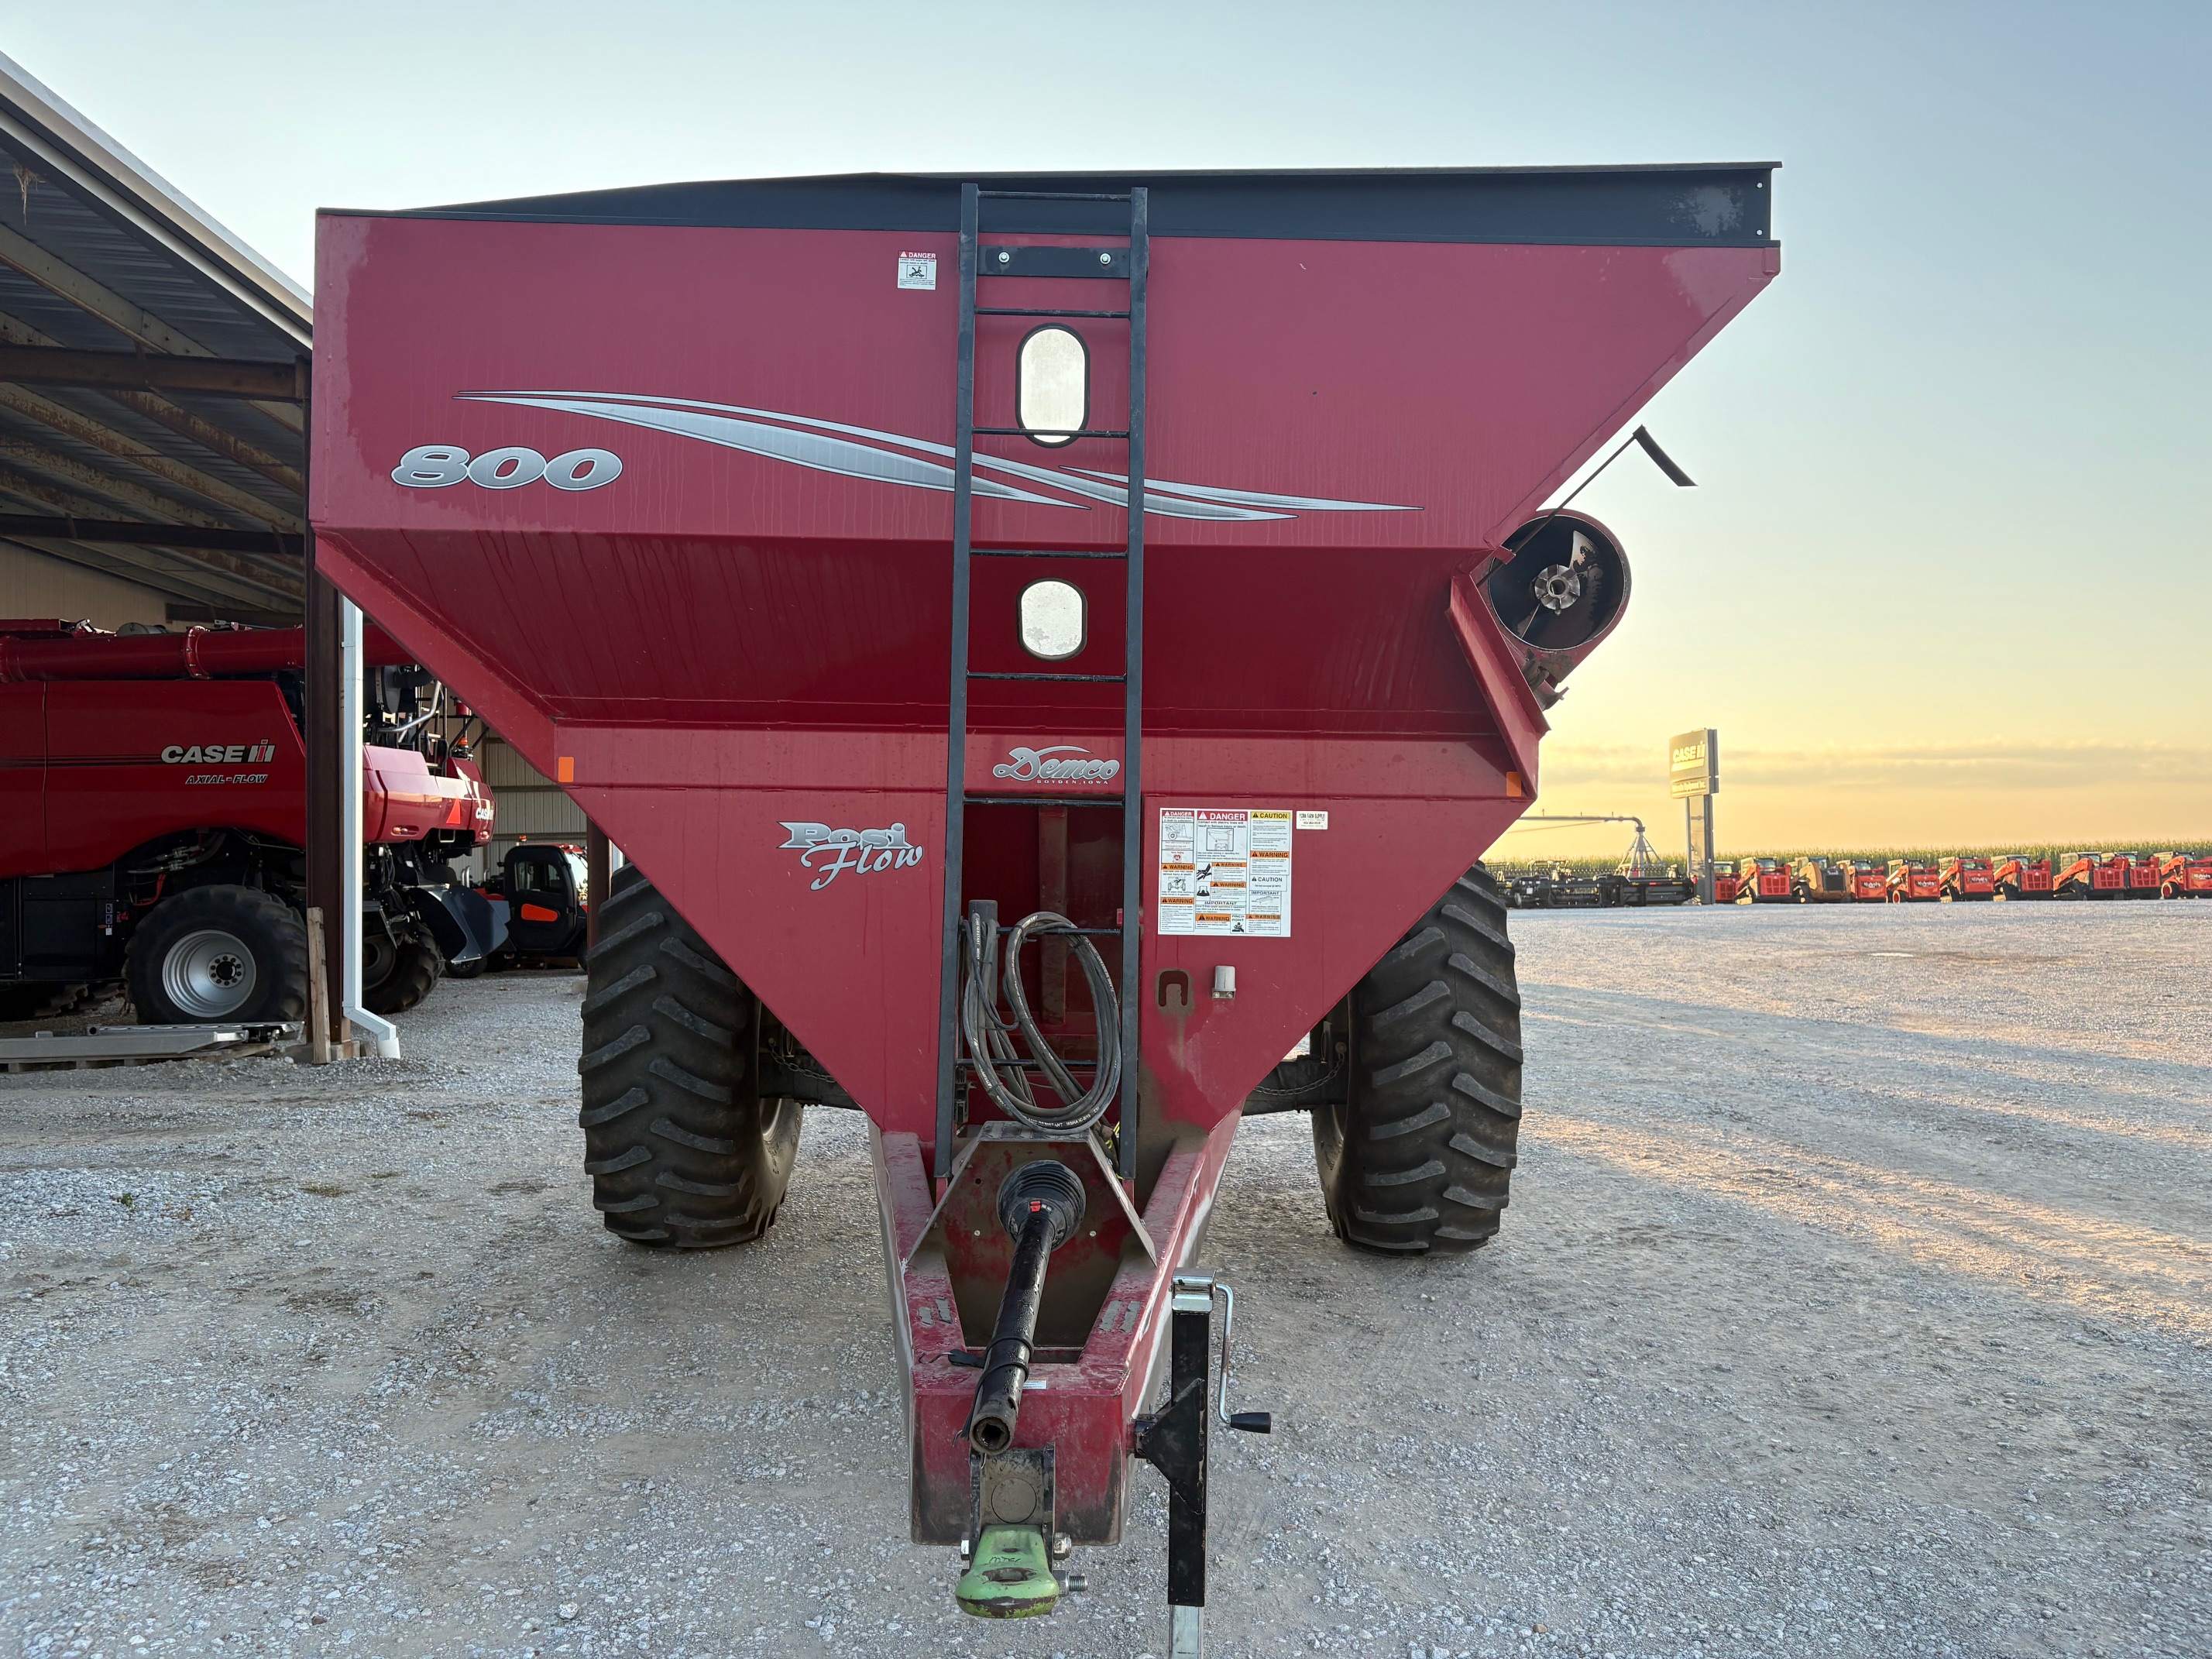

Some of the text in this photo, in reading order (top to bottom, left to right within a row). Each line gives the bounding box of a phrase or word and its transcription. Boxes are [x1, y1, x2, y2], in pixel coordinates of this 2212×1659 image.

[390, 444, 624, 492] 800
[161, 744, 246, 764] CASE
[992, 745, 1121, 781] Demco
[1673, 745, 1697, 763] CASE
[775, 821, 915, 850] Posi
[800, 840, 923, 891] Flow
